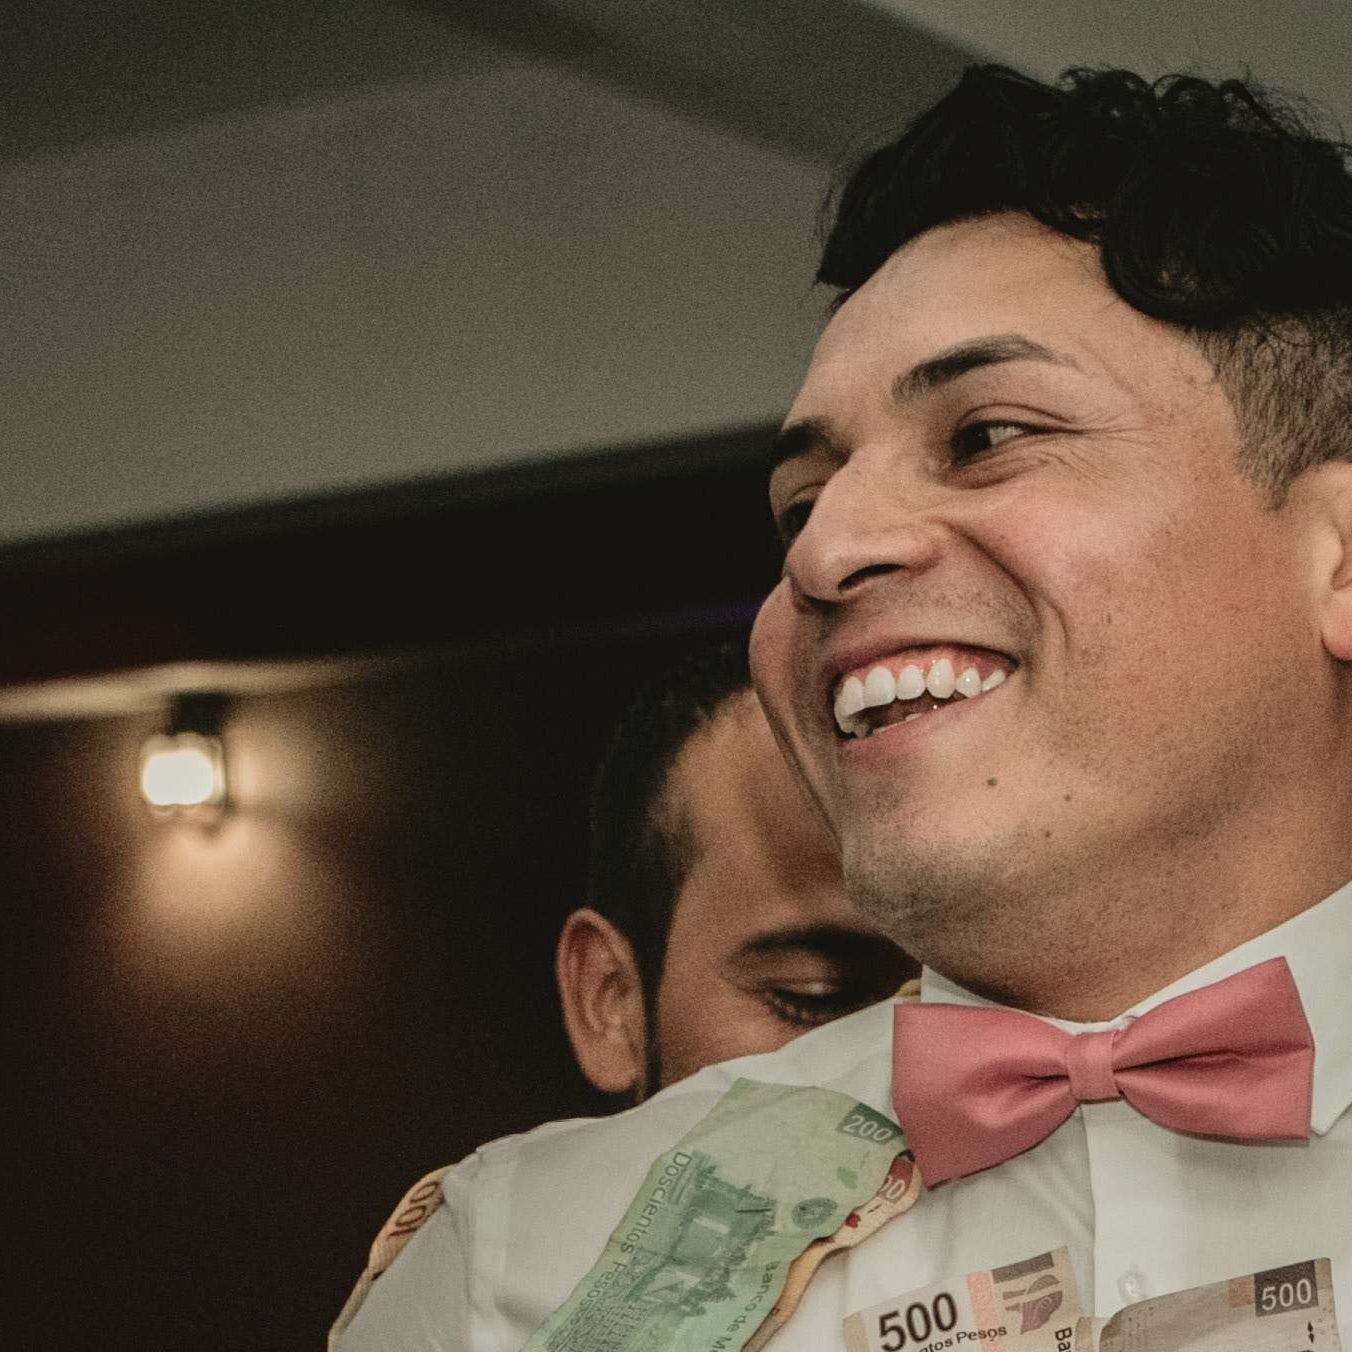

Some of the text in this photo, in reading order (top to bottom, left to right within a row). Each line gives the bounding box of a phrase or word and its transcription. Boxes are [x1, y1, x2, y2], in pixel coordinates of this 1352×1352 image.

[842, 1113, 893, 1142] 200
[620, 1151, 693, 1254] Doscientos
[744, 1261, 781, 1312] Banco
[1260, 1278, 1314, 1310] 500
[726, 1314, 745, 1333] de
[878, 1291, 958, 1352] 500
[956, 1325, 1008, 1345] Pesos
